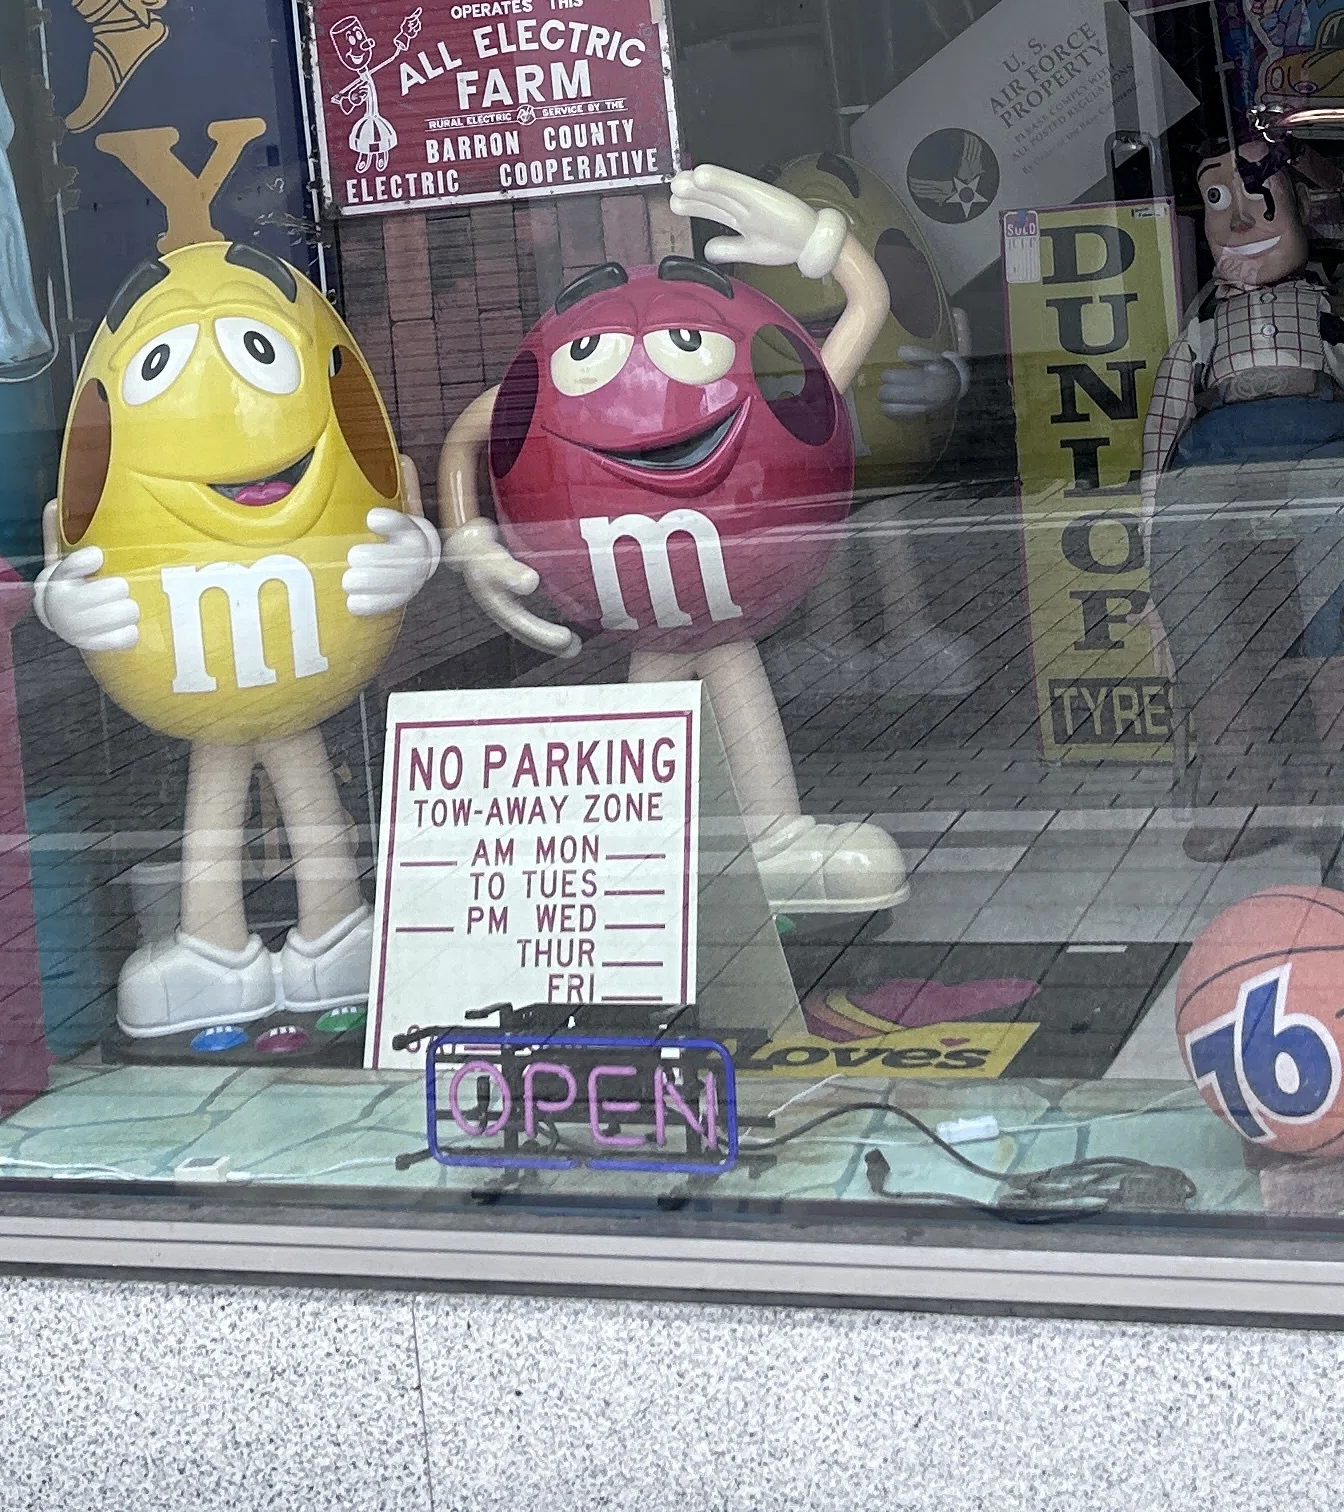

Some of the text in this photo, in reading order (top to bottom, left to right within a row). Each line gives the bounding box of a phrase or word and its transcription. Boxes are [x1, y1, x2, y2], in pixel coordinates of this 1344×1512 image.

[399, 19, 646, 96] ALL ELECTRIC
[990, 21, 1096, 114] AIR FORCE
[1002, 38, 1047, 73] U. S.
[456, 59, 592, 110] FARM
[999, 39, 1105, 129] PROPERTY
[429, 118, 463, 130] RURAL
[467, 113, 512, 125] ELECTRIC
[542, 104, 583, 117] SERVICE
[588, 102, 600, 112] BY
[605, 100, 625, 110] THE
[426, 119, 635, 164] BARRON COUNTY
[346, 148, 658, 204] ELECTRIC COOPERATIVE
[579, 509, 743, 630] m
[161, 554, 328, 693] m
[409, 737, 676, 791] NO PARKING
[414, 792, 664, 828] TOW-AWAY ZONE
[471, 834, 600, 867] AM MON
[470, 869, 598, 900] TO TUES
[467, 904, 597, 935] PM WED
[517, 938, 595, 968] THUR
[548, 974, 594, 1003] FRI
[1185, 963, 1342, 1144] 76
[449, 1058, 719, 1151] OPEN
